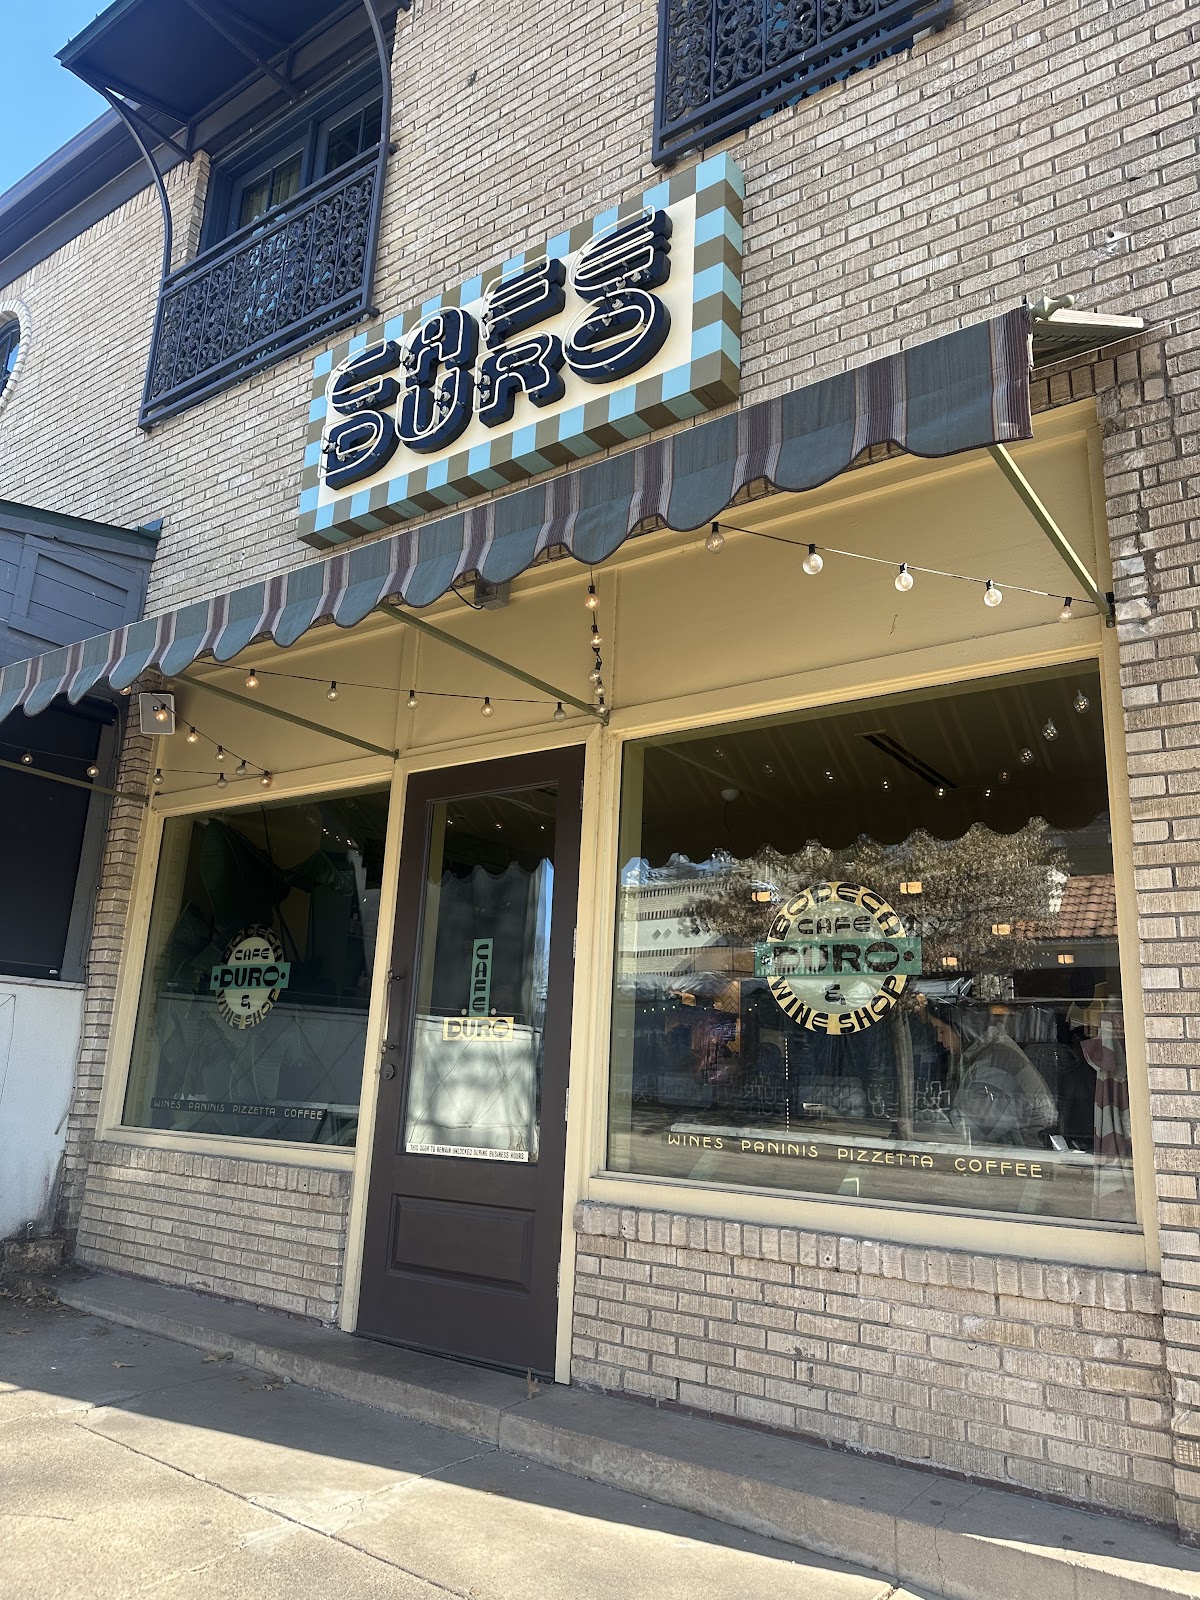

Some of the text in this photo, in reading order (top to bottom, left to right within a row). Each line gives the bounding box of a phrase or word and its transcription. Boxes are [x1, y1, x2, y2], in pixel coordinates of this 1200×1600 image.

[325, 204, 673, 415] CAFE
[317, 287, 672, 490] DURO
[798, 916, 870, 934] CAFE
[235, 948, 270, 960] CAFE
[773, 941, 899, 973] DURO
[219, 965, 279, 988] DURO
[473, 944, 489, 1013] CAFE
[217, 988, 279, 1029] WINE SHOP
[770, 974, 902, 1035] WINE SHOP
[825, 984, 846, 1005] &
[447, 1018, 509, 1038] DURO
[153, 1100, 323, 1120] WINES PANINIS PIZZETTA COFFEE
[667, 1133, 1043, 1178] WINES PANINIS PIZZETTA COFFEE
